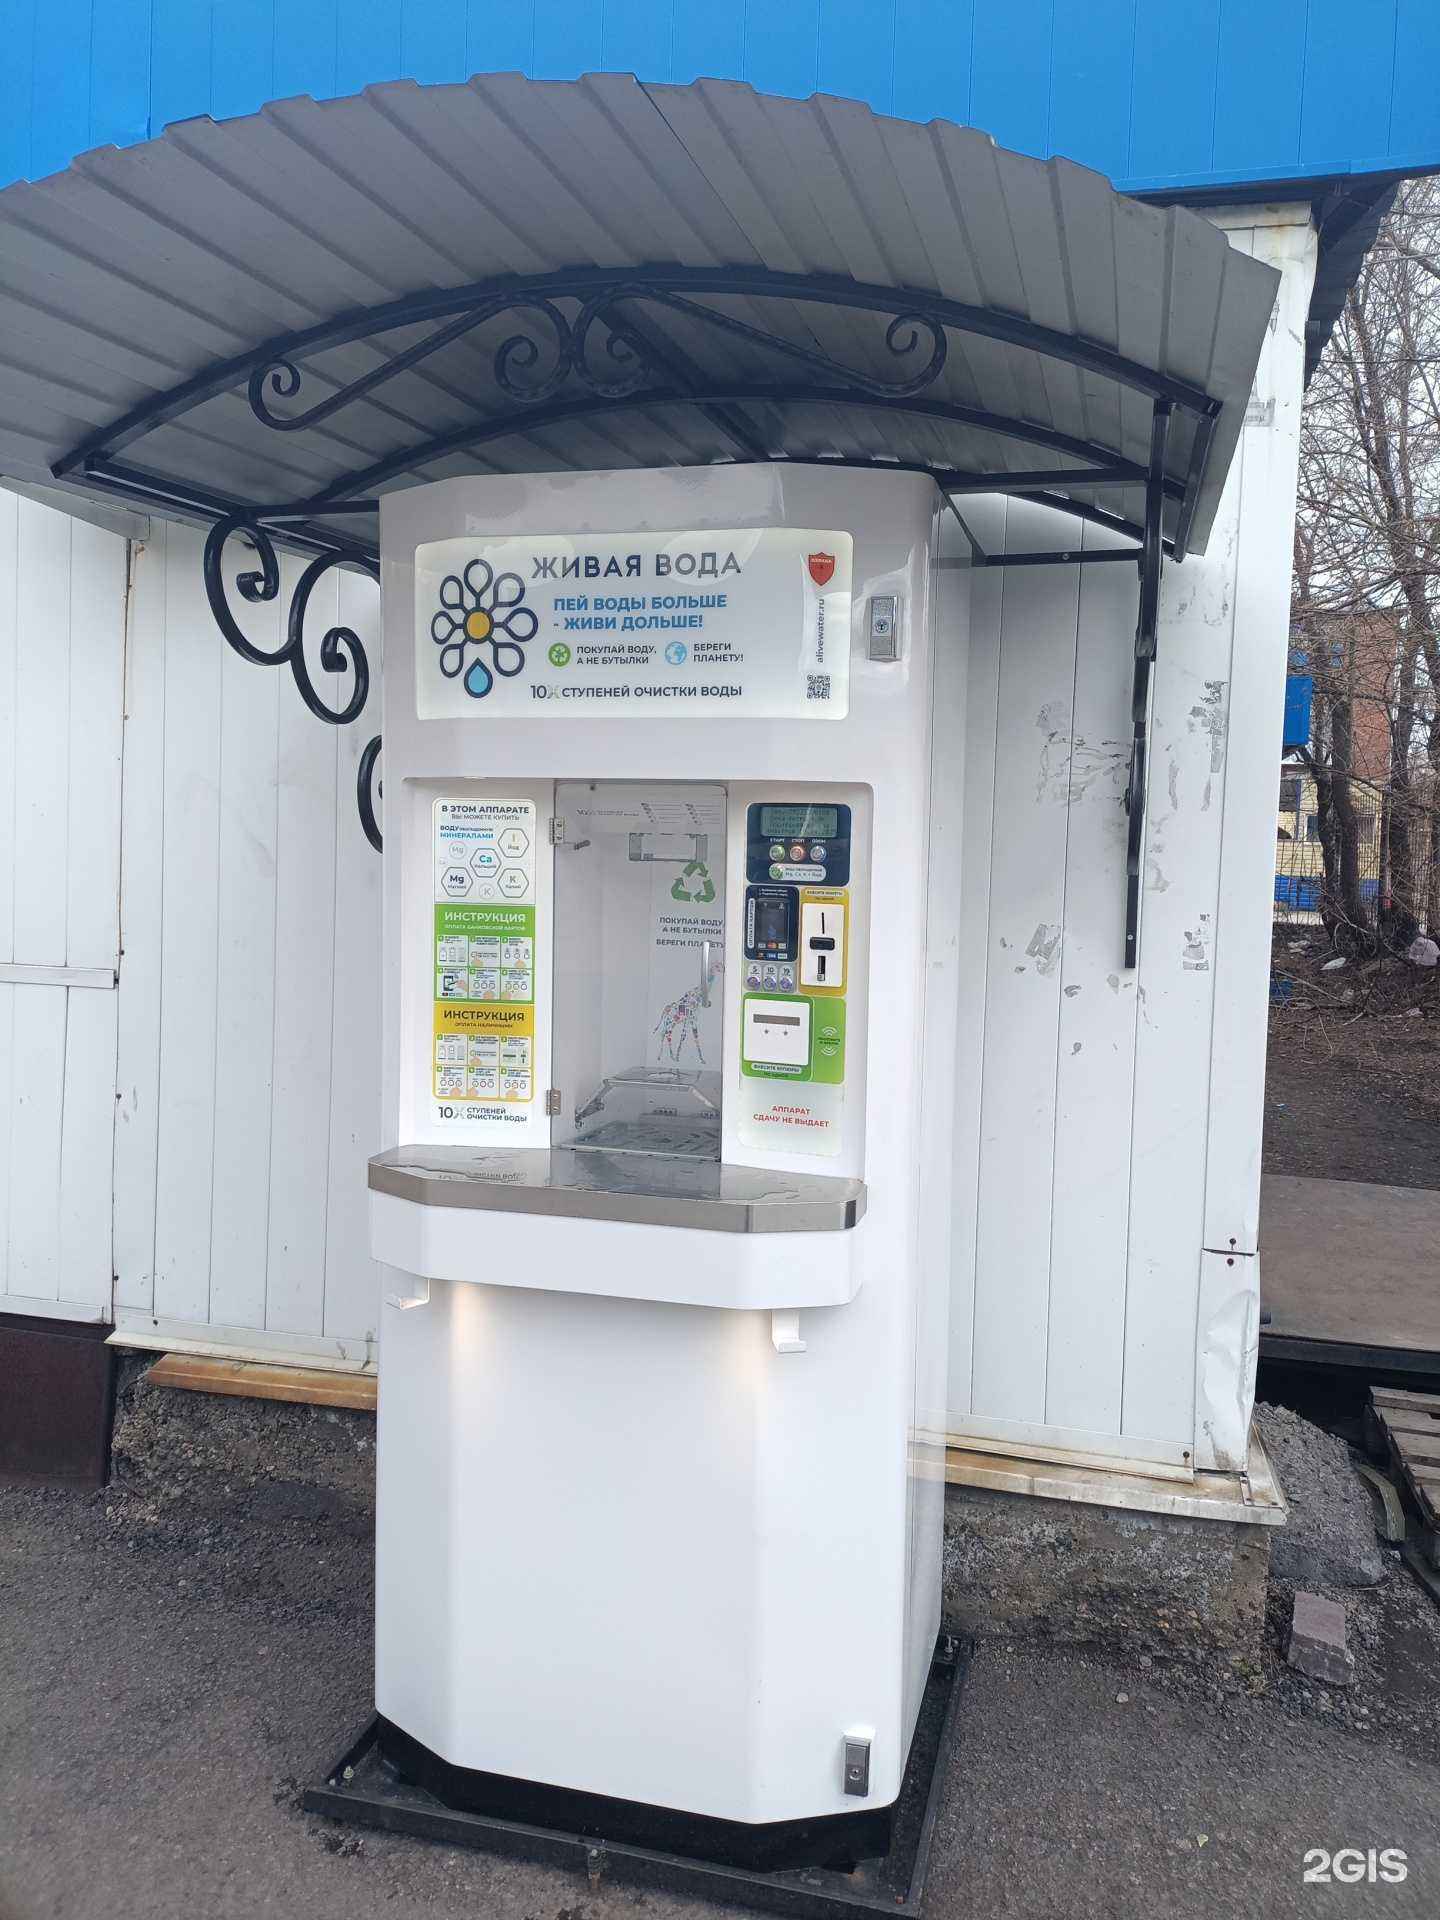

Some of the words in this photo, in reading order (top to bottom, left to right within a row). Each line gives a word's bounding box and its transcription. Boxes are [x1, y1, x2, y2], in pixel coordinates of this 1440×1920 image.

[531, 555, 641, 578] ЖИВАЯ
[655, 552, 741, 578] ВОДА
[554, 594, 588, 611] ПЕЙ
[593, 597, 645, 612] ВОДЫ
[651, 594, 727, 610] БОЛЬШЕ
[564, 616, 616, 630] ЖИВИ
[621, 614, 703, 631] ДОЛЬШЕ!
[816, 599, 825, 663] alivewater.ru
[576, 643, 625, 654] ПОКУПАЙ
[693, 643, 731, 652] БЕРЕГИ
[576, 656, 584, 665] А
[586, 656, 599, 665] НЕ
[602, 656, 649, 665] БУТЫЛКИ
[693, 653, 743, 663] ПЛАНЕТУ!
[562, 685, 630, 698] СТУПЕНЕЙ
[634, 687, 697, 698] ОЧИСТКИ
[701, 686, 742, 698] ВОДЫ
[441, 805, 448, 813] В
[450, 805, 477, 813] ЭТОМ
[479, 806, 529, 814] АППАРАТЕ
[479, 855, 493, 863] Ca
[449, 875, 465, 884] Mg
[444, 912, 526, 923] ИНСТРУКЦИЯ
[660, 917, 699, 925] ПОКУПАЙ
[444, 1010, 525, 1022] ИНСТРУКЦИЯ
[772, 1105, 811, 1115] АППАРАТ
[753, 1114, 780, 1123] СДАЧУ
[795, 1118, 830, 1127] ВЫДАЕТ
